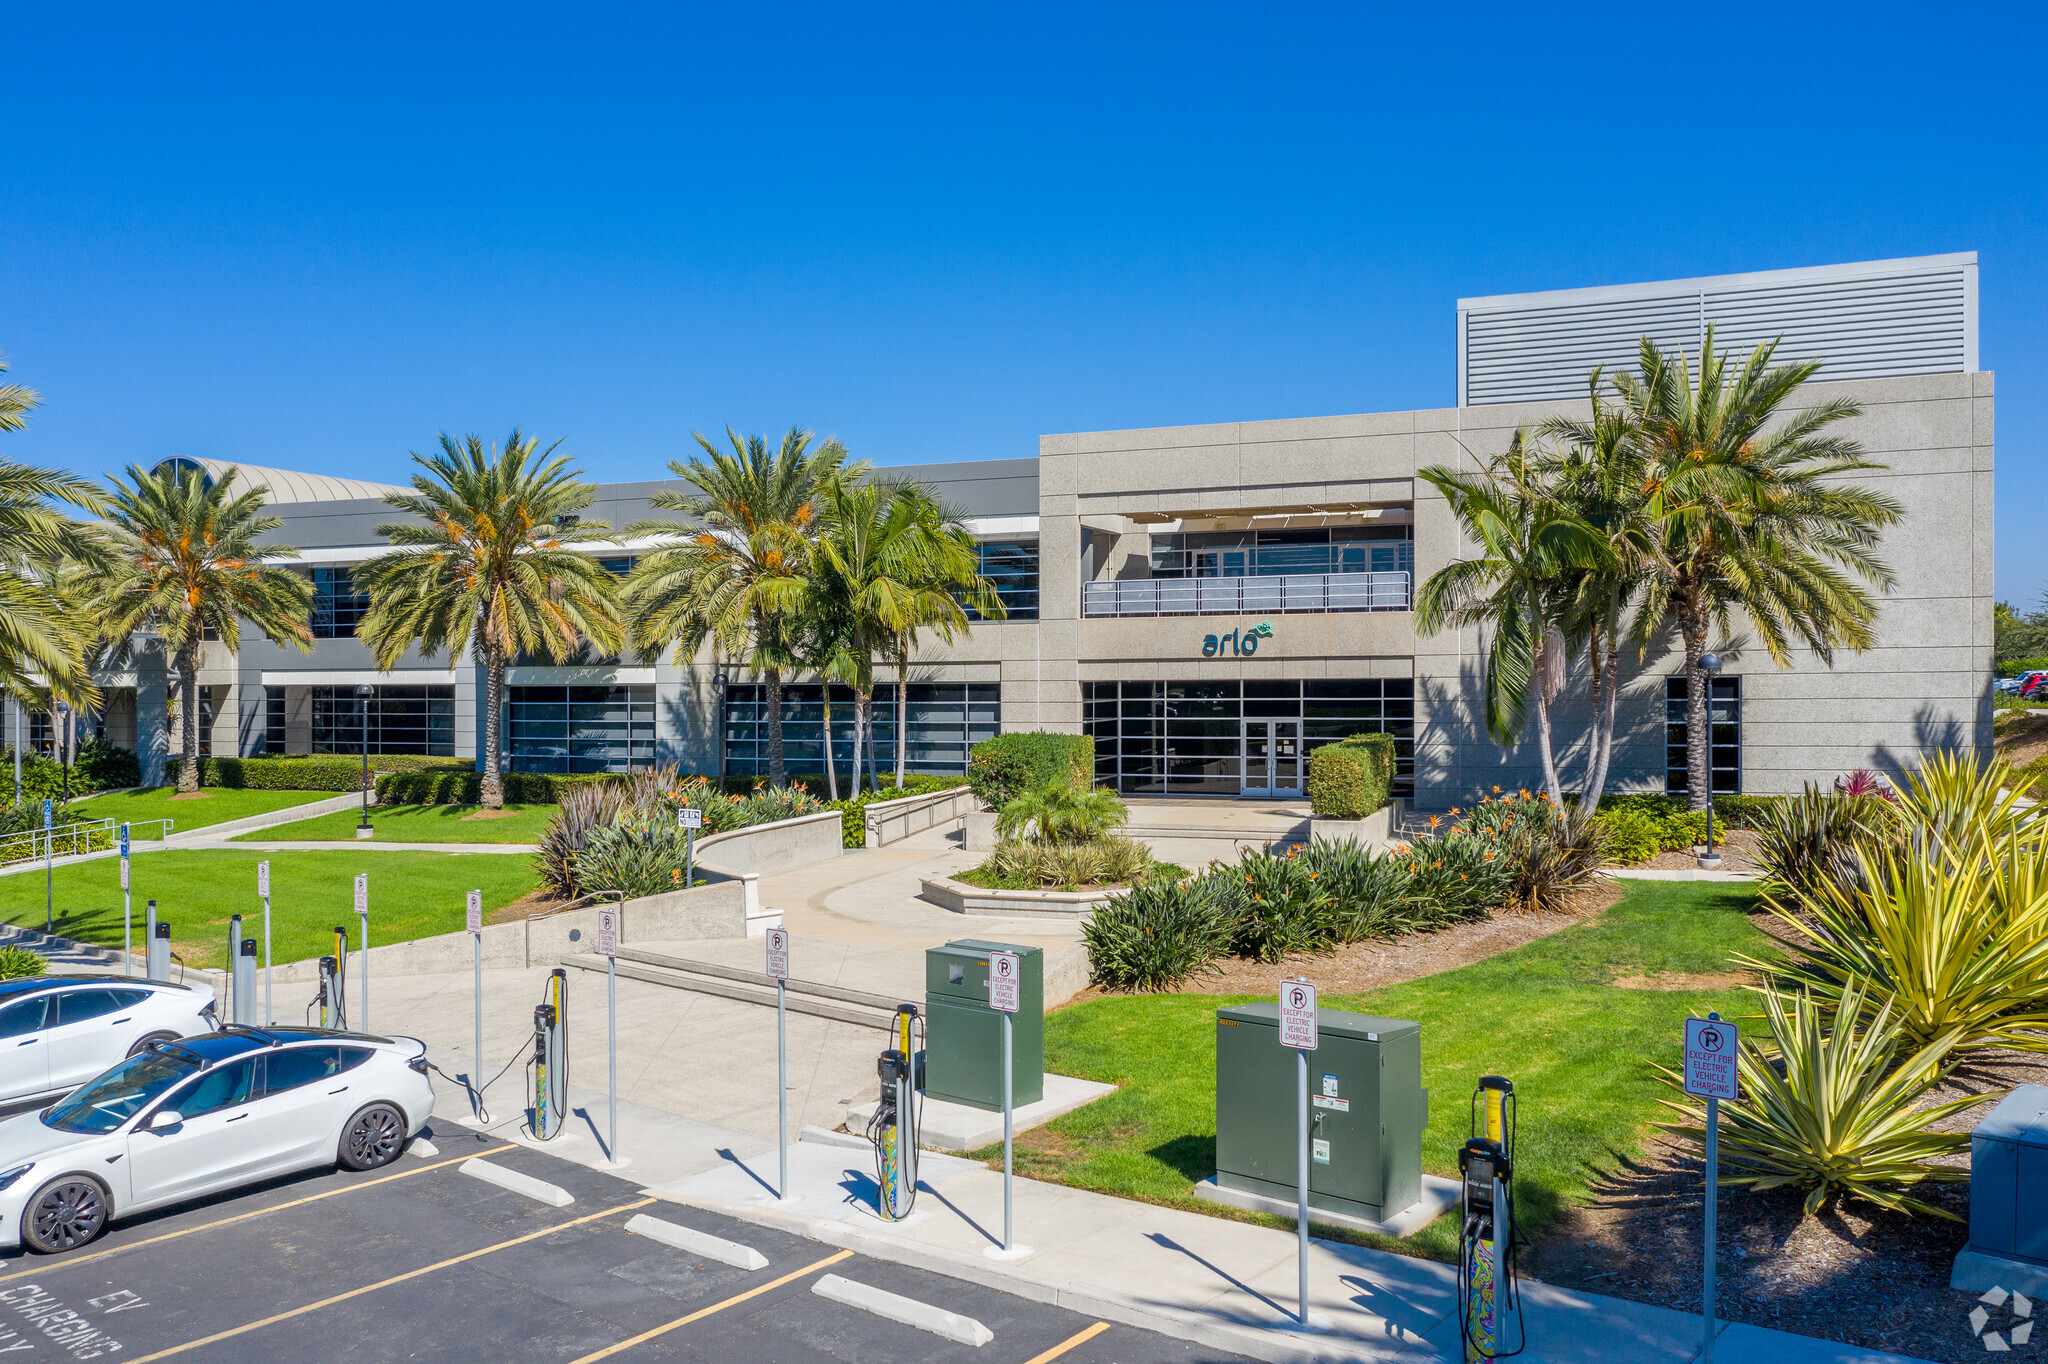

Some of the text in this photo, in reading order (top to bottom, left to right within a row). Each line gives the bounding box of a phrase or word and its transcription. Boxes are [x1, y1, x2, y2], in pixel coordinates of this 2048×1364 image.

[1203, 627, 1258, 653] arlo
[994, 998, 1014, 1006] CHARGING
[1283, 1008, 1302, 1017] EXCEPT
[1286, 1017, 1310, 1026] ELECTRIC
[1288, 1026, 1309, 1034] VEHICLE
[1285, 1033, 1312, 1043] CHARGING
[1689, 1050, 1733, 1064] EXCEPT FOR
[1694, 1061, 1728, 1073] ELECTRIC
[1695, 1071, 1726, 1083] VEHICLE
[1692, 1080, 1729, 1093] CHARGING
[87, 1290, 150, 1314] EV
[0, 1284, 122, 1359] CHARGING
